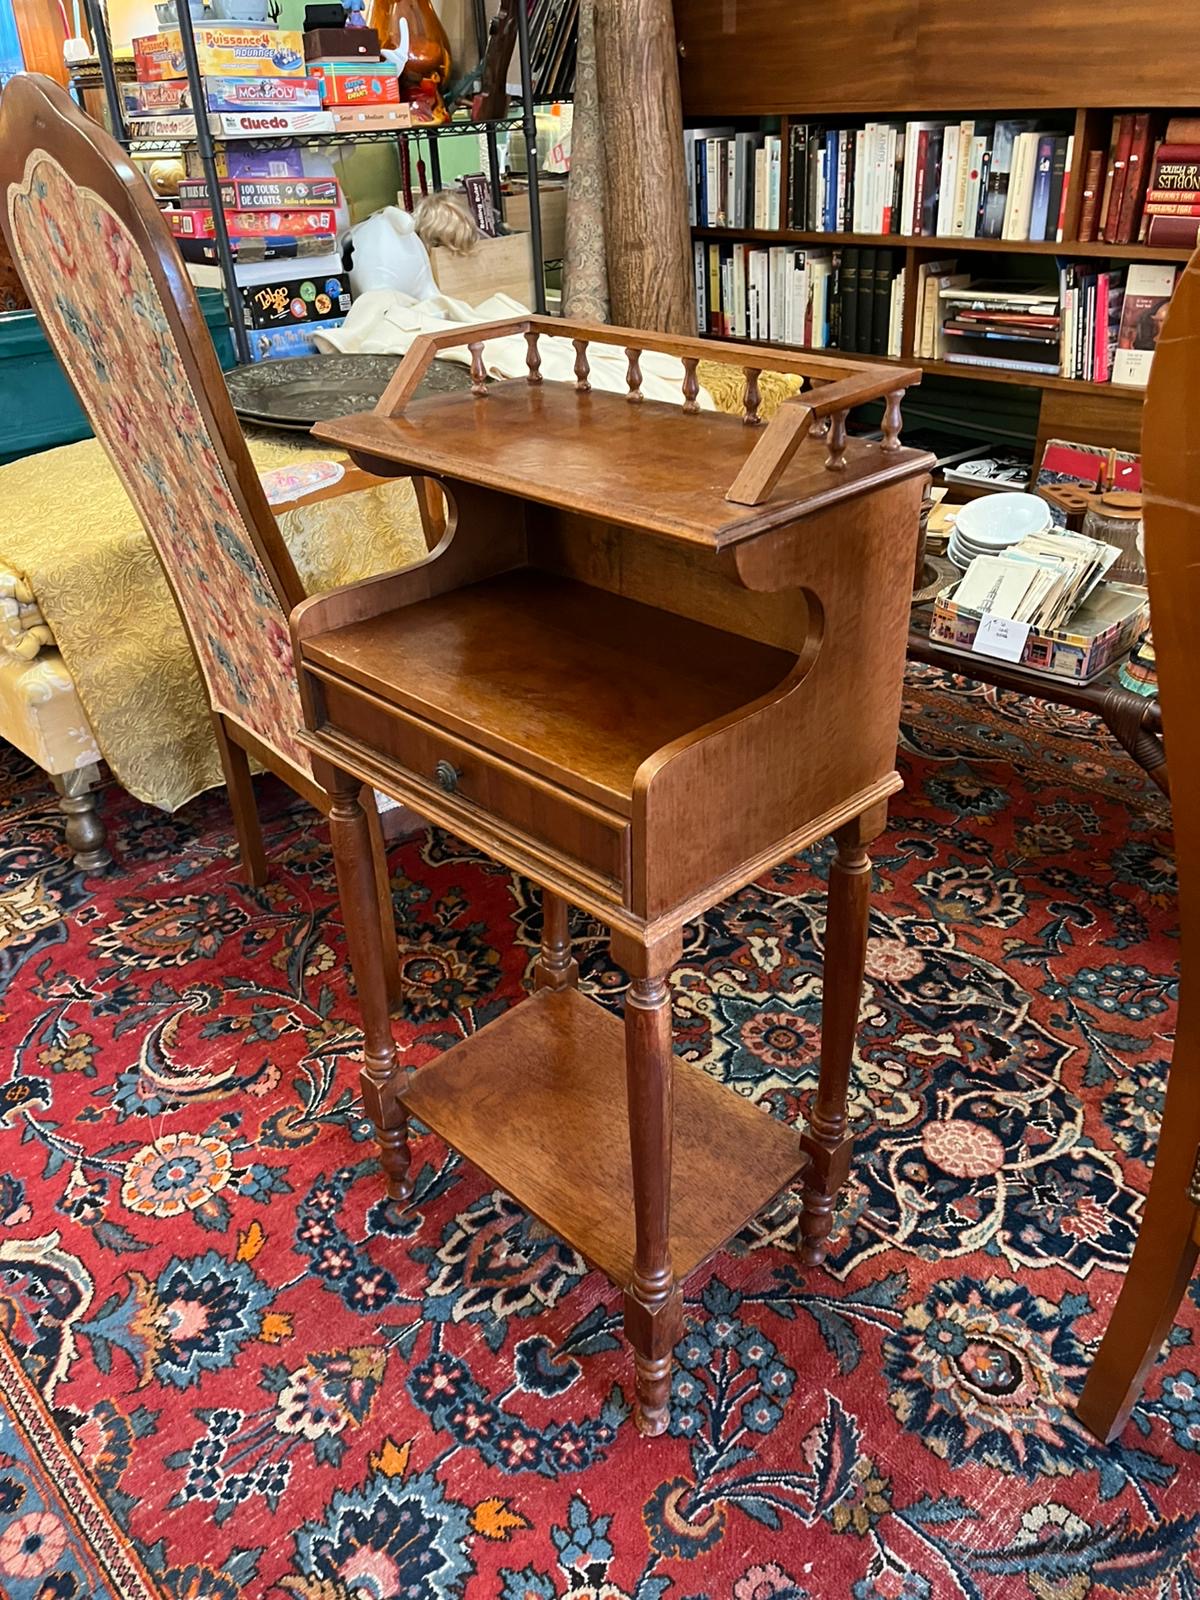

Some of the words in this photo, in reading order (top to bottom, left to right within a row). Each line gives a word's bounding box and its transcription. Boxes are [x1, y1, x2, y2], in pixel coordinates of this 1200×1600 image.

[205, 32, 261, 46] Puissance
[262, 34, 270, 46] 4
[234, 48, 275, 58] ADVANCE
[239, 117, 289, 130] Cluedo
[1160, 165, 1187, 176] France
[1186, 166, 1198, 175] de
[1158, 174, 1200, 190] NOBLES
[241, 185, 255, 194] 100
[255, 185, 279, 194] TOURS
[242, 196, 252, 205] DE
[253, 195, 281, 205] CARTES
[254, 286, 289, 310] Taboo
